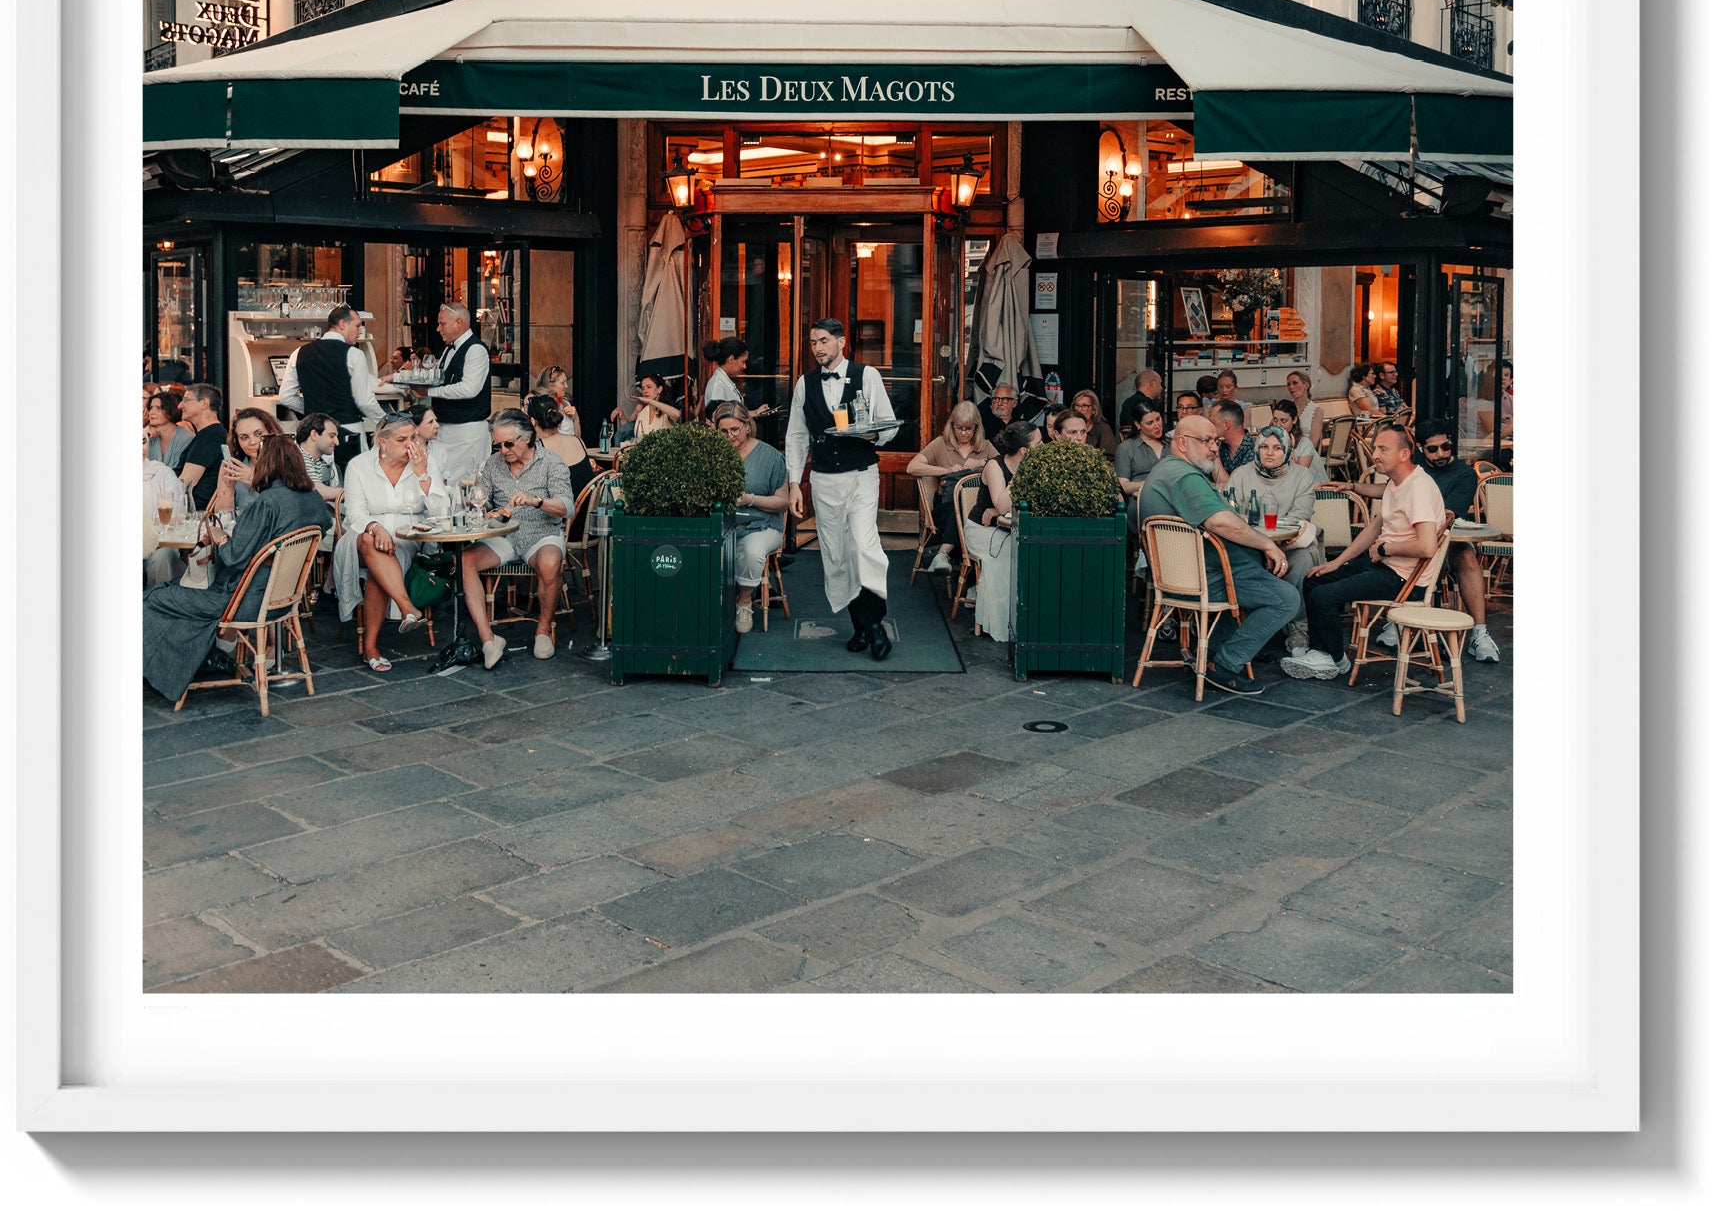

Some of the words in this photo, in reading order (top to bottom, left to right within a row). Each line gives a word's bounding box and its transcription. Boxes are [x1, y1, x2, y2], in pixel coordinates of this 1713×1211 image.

[399, 79, 440, 96] CAFÉ
[700, 74, 750, 102] LES
[759, 74, 835, 102] DEUX
[840, 74, 956, 102] MAGOTS
